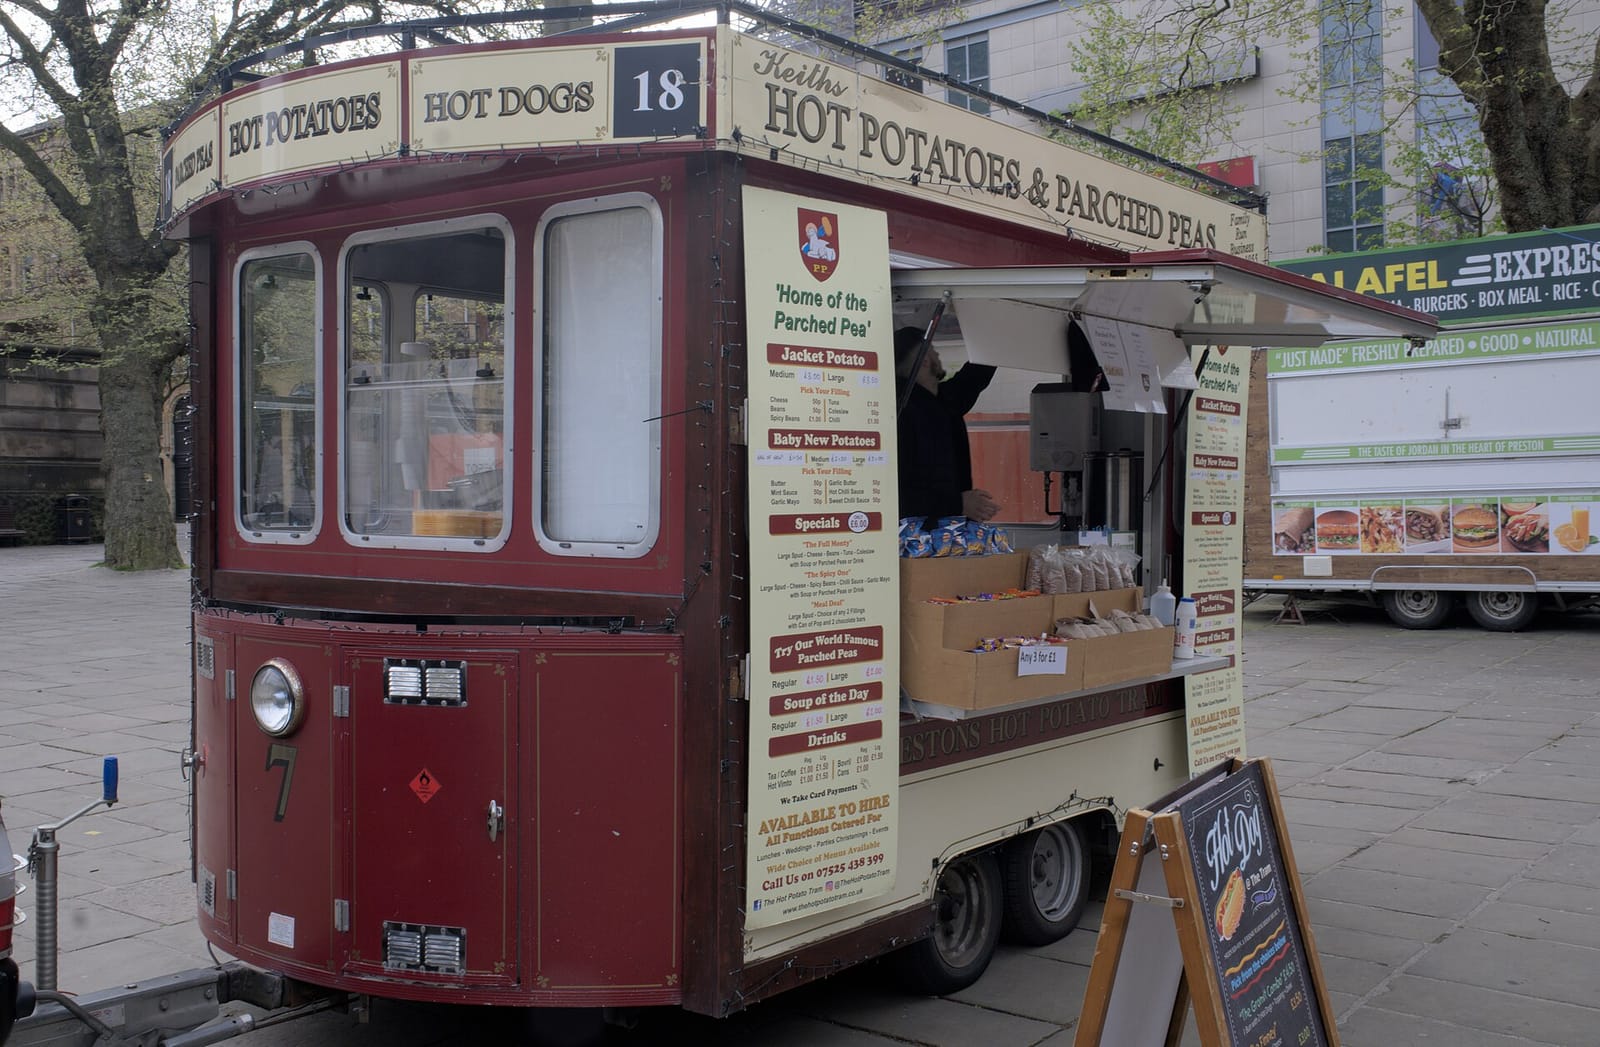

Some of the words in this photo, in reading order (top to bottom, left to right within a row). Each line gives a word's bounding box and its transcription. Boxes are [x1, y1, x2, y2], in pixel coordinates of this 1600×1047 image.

[753, 49, 850, 98] Keiths
[424, 89, 492, 123] HOT
[498, 81, 595, 118] DOGS
[632, 68, 685, 112] 18
[229, 115, 264, 158] HOT
[265, 92, 382, 147] POTATOES
[764, 82, 851, 151] HOT
[859, 111, 1021, 200] POTATOES
[1029, 166, 1050, 207] &
[1056, 174, 1164, 241] PARCHED
[1169, 210, 1217, 251] PEAS
[827, 291, 843, 309] of
[845, 293, 868, 312] the
[1414, 293, 1468, 313] BURGERS
[1479, 289, 1505, 308] BOX
[1508, 286, 1542, 305] MEAL
[1553, 282, 1581, 301] RICE
[774, 311, 837, 335] Parched
[840, 318, 871, 338] Pea'
[781, 347, 824, 364] Jacket
[826, 350, 865, 366] Potato
[1352, 343, 1401, 363] FRESHLY
[1480, 333, 1519, 352] GOOD
[1535, 327, 1596, 348] NATURAL
[769, 370, 795, 379] Medium
[828, 373, 845, 383] Large
[773, 432, 803, 448] Baby
[804, 433, 830, 446] New
[831, 434, 876, 447] Potatoes
[1358, 447, 1372, 457] THE
[1374, 446, 1394, 457] TASTE
[1397, 446, 1406, 456] OF
[1408, 444, 1439, 456] JORDAN
[1441, 444, 1450, 455] IN
[1452, 443, 1467, 454] THE
[1468, 442, 1493, 453] HEART
[1495, 441, 1507, 452] OF
[1508, 440, 1545, 451] PRESTON
[795, 517, 841, 531] Specials
[774, 644, 793, 659] Try
[795, 640, 814, 651] Our
[815, 634, 843, 647] World
[844, 634, 879, 647] Famous
[798, 650, 836, 664] Parched
[837, 649, 858, 659] Peas
[1020, 652, 1032, 664] Any
[1033, 652, 1037, 662] 3
[1039, 651, 1047, 662] for
[1049, 652, 1056, 662] £1
[772, 679, 797, 690] Regular
[831, 672, 848, 681] Large
[784, 698, 813, 710] Soup
[815, 694, 827, 706] of
[828, 691, 847, 704] the
[849, 688, 869, 701] Day
[772, 720, 797, 731] Regular
[830, 712, 848, 721] Large
[990, 709, 1032, 743] HOT
[1039, 699, 1110, 733] POTATO
[1119, 684, 1164, 714] TRAM
[807, 731, 847, 747] Drinks
[265, 744, 297, 822] 7
[768, 772, 777, 781] Tea
[781, 769, 797, 778] Coffee
[768, 782, 777, 791] Hot
[777, 780, 792, 788] Vimto
[837, 768, 849, 777] Cans
[780, 797, 791, 805] We
[792, 795, 808, 803] Take
[810, 791, 825, 800] Card
[827, 784, 858, 797] Payments
[757, 804, 837, 835] AVAILABLE
[838, 801, 857, 817] TO
[859, 794, 891, 813] HIRE
[765, 835, 781, 847] All
[783, 826, 829, 843] Functions
[831, 818, 866, 832] Catered
[867, 813, 882, 824] For
[757, 851, 781, 862] Lunches
[785, 844, 813, 855] Weddings
[817, 839, 835, 848] Parties
[872, 826, 889, 835] Events
[1206, 806, 1234, 891] Hot
[1234, 803, 1263, 872] Dog
[766, 864, 786, 874] Wide
[788, 859, 812, 870] Choice
[815, 855, 822, 864] of
[823, 849, 847, 861] Menus
[848, 841, 881, 855] Available
[762, 878, 783, 891] Call
[786, 874, 799, 885] Us
[801, 871, 814, 881] on
[816, 862, 846, 879] 07525
[848, 857, 865, 871] 438
[867, 853, 884, 866] 399
[1250, 872, 1261, 887] The
[1259, 864, 1272, 877] Tram
[763, 899, 775, 908] The
[776, 895, 787, 905] Hot
[788, 890, 807, 901] Potato
[809, 886, 823, 896] Tram
